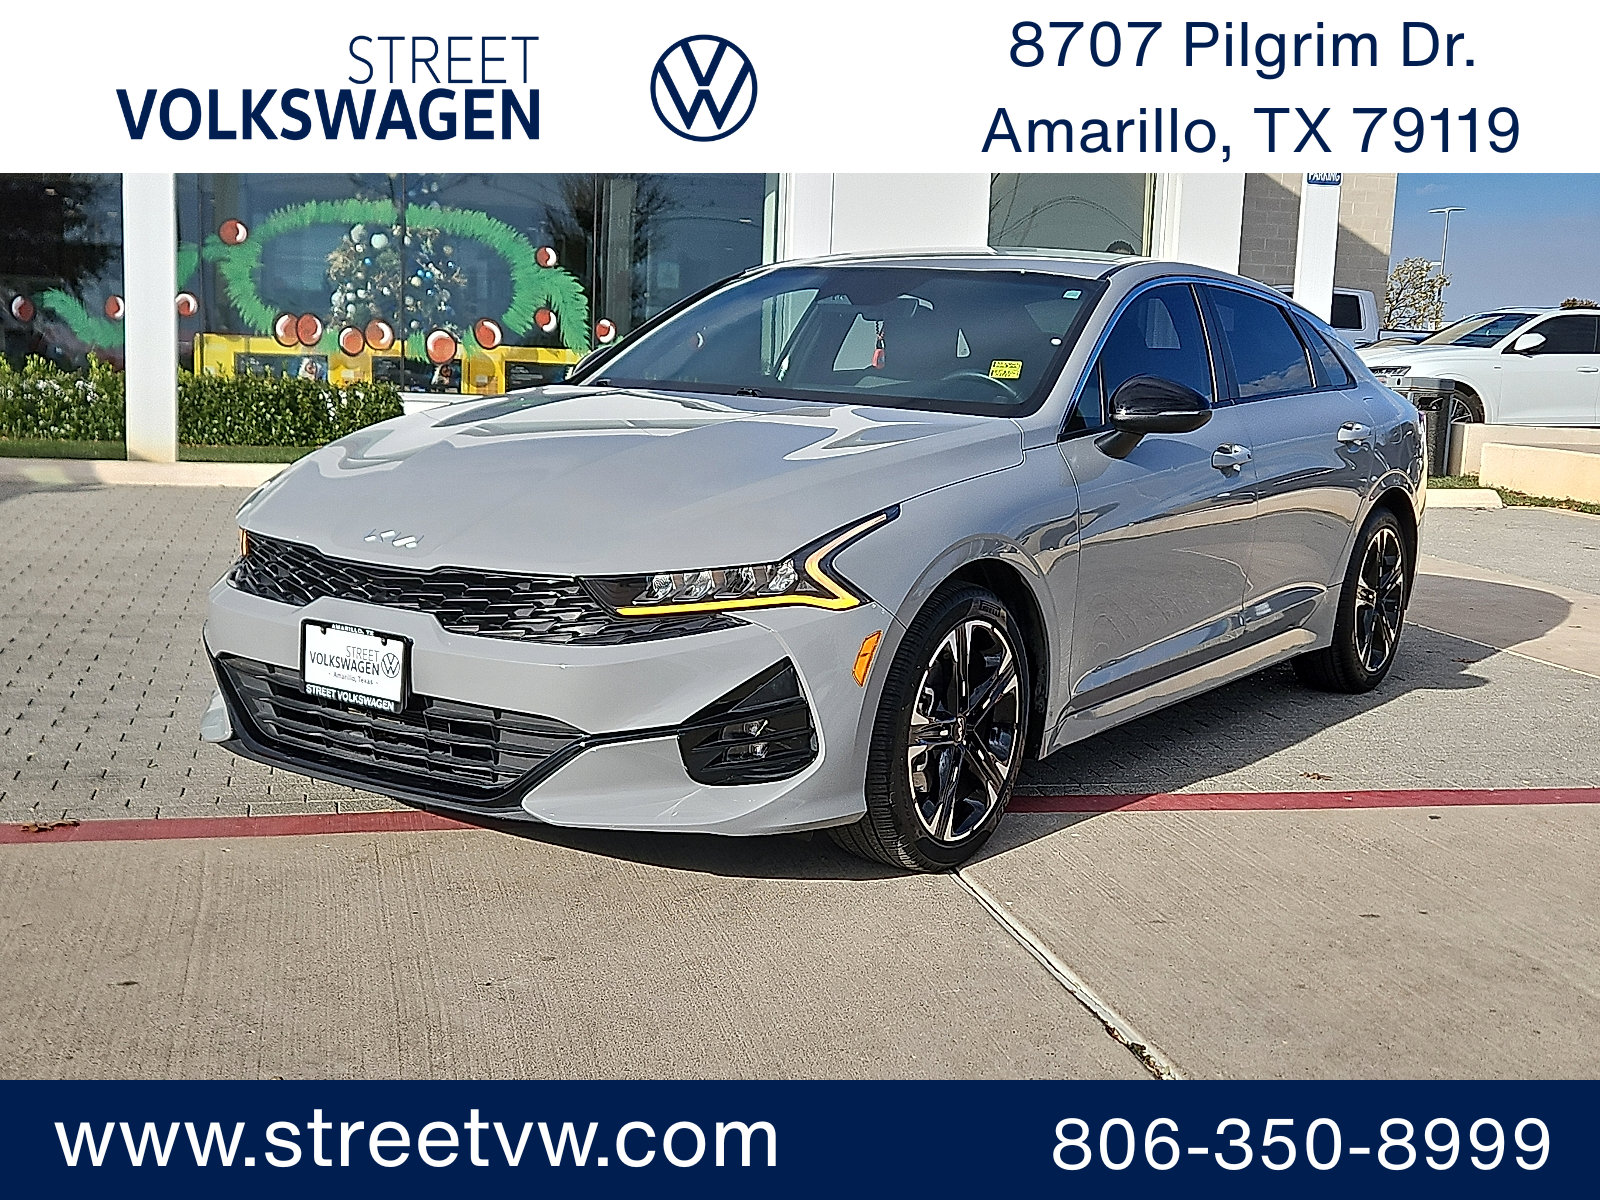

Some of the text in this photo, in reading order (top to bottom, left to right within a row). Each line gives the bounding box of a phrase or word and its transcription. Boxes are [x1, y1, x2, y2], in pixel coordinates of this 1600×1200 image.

[309, 650, 380, 676] VOLKSWAGEN
[346, 645, 380, 662] STREET
[306, 684, 395, 711] STREET VOLKSWAGEN
